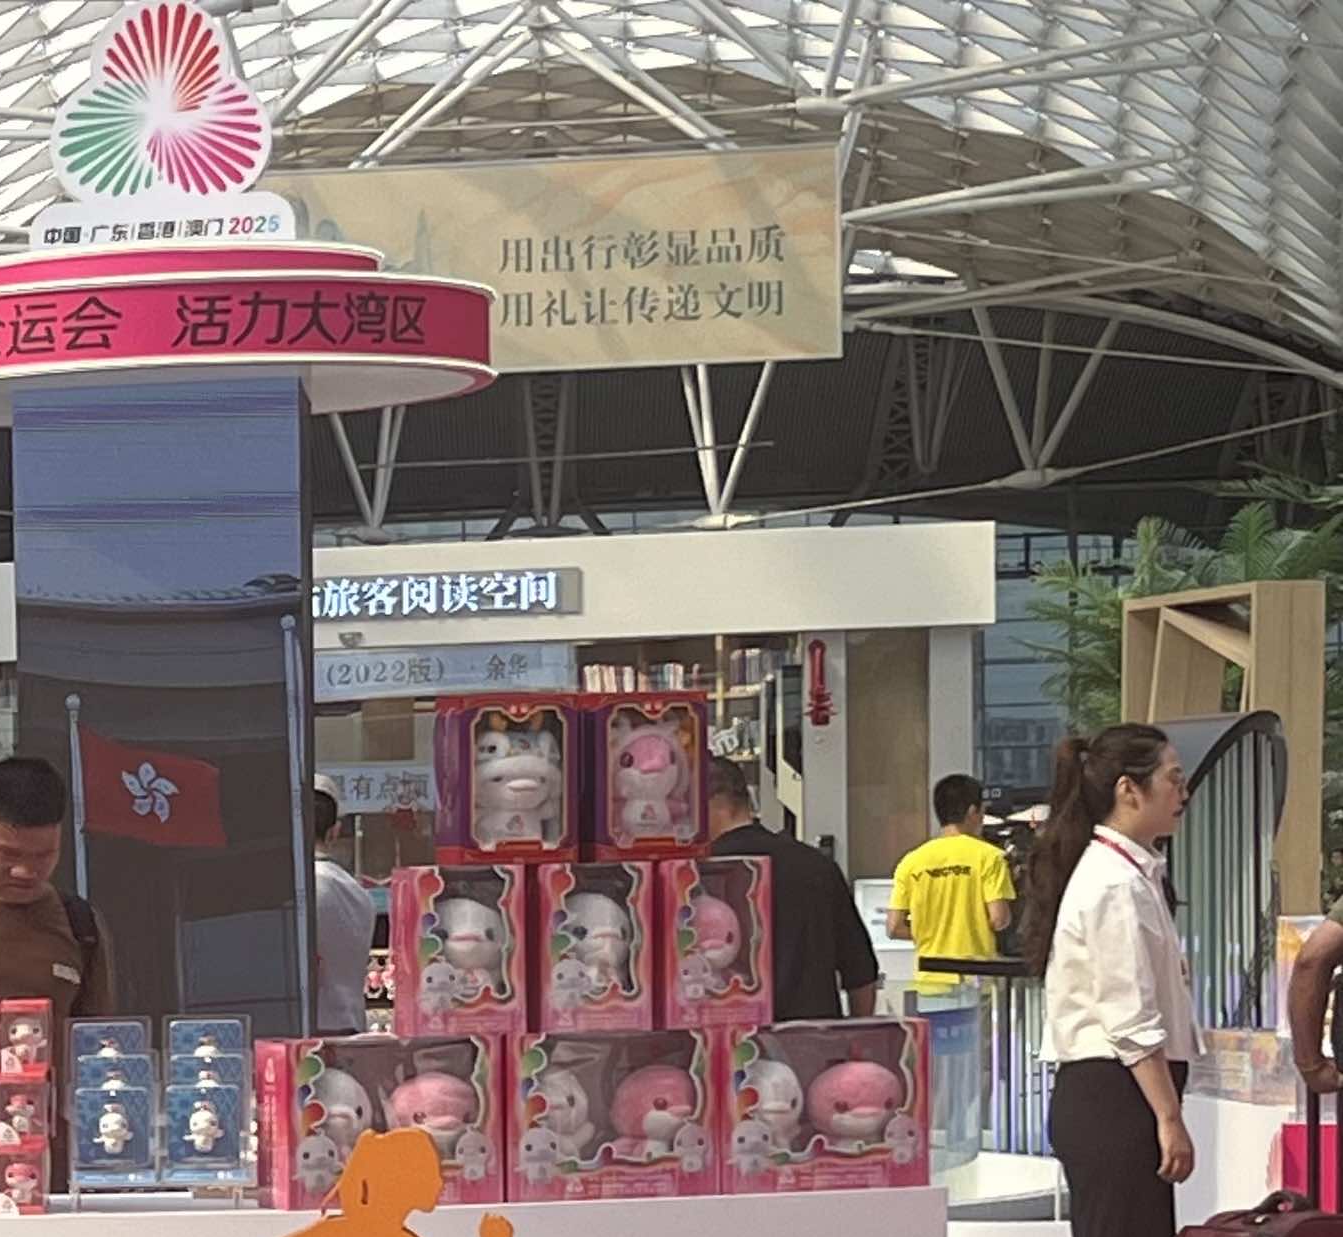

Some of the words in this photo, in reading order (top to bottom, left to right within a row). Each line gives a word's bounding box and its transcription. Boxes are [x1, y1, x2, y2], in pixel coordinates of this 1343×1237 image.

[227, 213, 282, 236] 2025
[498, 223, 786, 274] 用出行彰显品质
[170, 290, 428, 348] 活力大湾区
[499, 279, 785, 328] 用礼让传递文明
[312, 570, 557, 618] 旅客阅读空间
